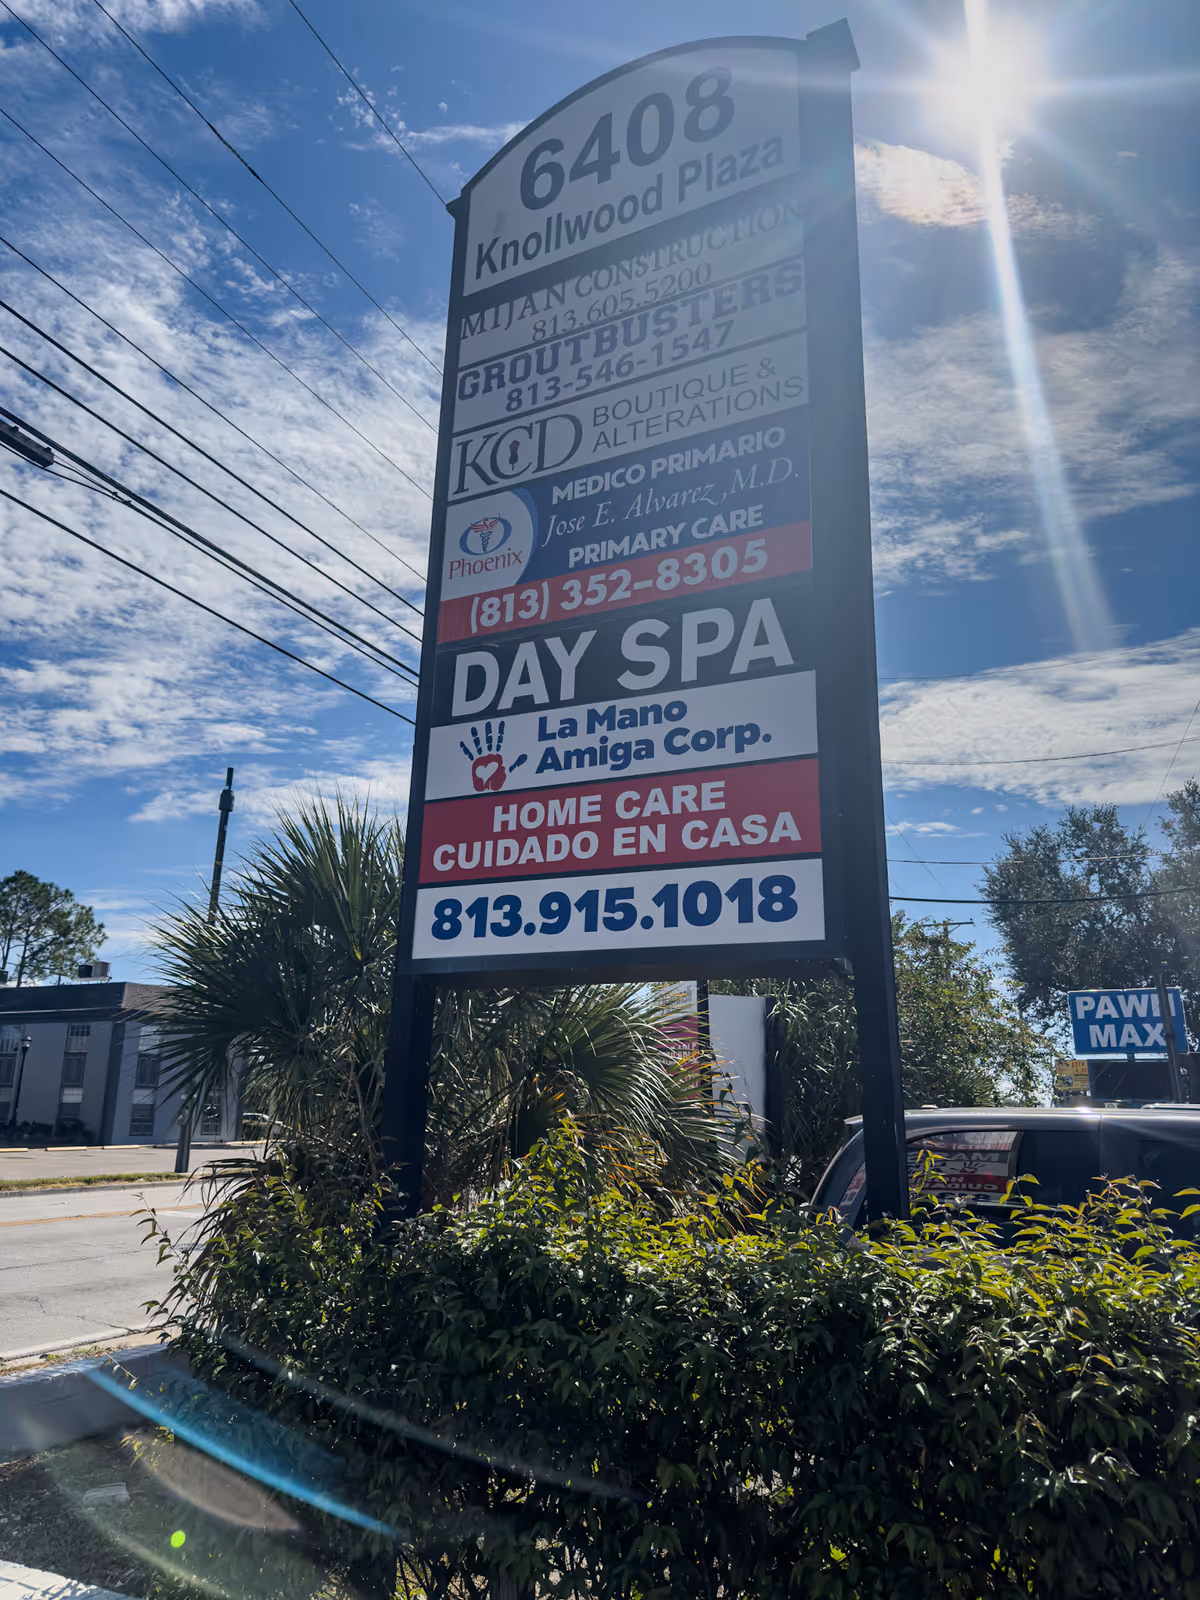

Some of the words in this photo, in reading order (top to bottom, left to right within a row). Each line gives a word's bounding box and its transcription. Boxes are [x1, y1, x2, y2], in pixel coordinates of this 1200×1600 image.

[520, 67, 735, 210] 6408
[475, 173, 663, 280] Knollwood
[678, 136, 784, 203] Plaza
[460, 282, 567, 340] MIJAN
[574, 203, 801, 298] CONSTRUCTION
[532, 263, 712, 342] 813.605.5200
[458, 261, 801, 400] GROUTBUSTERS
[505, 320, 734, 412] 813-546-1547
[592, 375, 804, 453] ALTERATIONS
[593, 363, 748, 427] BOUTIQUE
[756, 357, 776, 379] &
[452, 413, 583, 495] KCD
[552, 463, 646, 505] MEDICO
[651, 426, 786, 479] PRIMARIO
[541, 513, 585, 548] Jose
[592, 501, 615, 527] E.
[568, 522, 686, 568] PRIMARY
[691, 504, 763, 540] CARE
[449, 548, 522, 580] Phoenix
[470, 581, 550, 634] (813)
[560, 538, 768, 611] 352-8305
[452, 629, 597, 717] DAY
[617, 597, 794, 690] SPA
[535, 735, 655, 774] Amiga
[663, 722, 772, 756] Corp.
[537, 716, 578, 742] La
[586, 700, 688, 735] Mano
[432, 830, 599, 872] CUIDADO
[612, 823, 666, 856] EN
[681, 811, 802, 850] CASA
[493, 794, 601, 832] HOME
[615, 780, 726, 819] CARE
[430, 874, 799, 941] 813.915.1018
[1075, 993, 1176, 1019] PAWN
[1088, 1023, 1167, 1048] MAX
